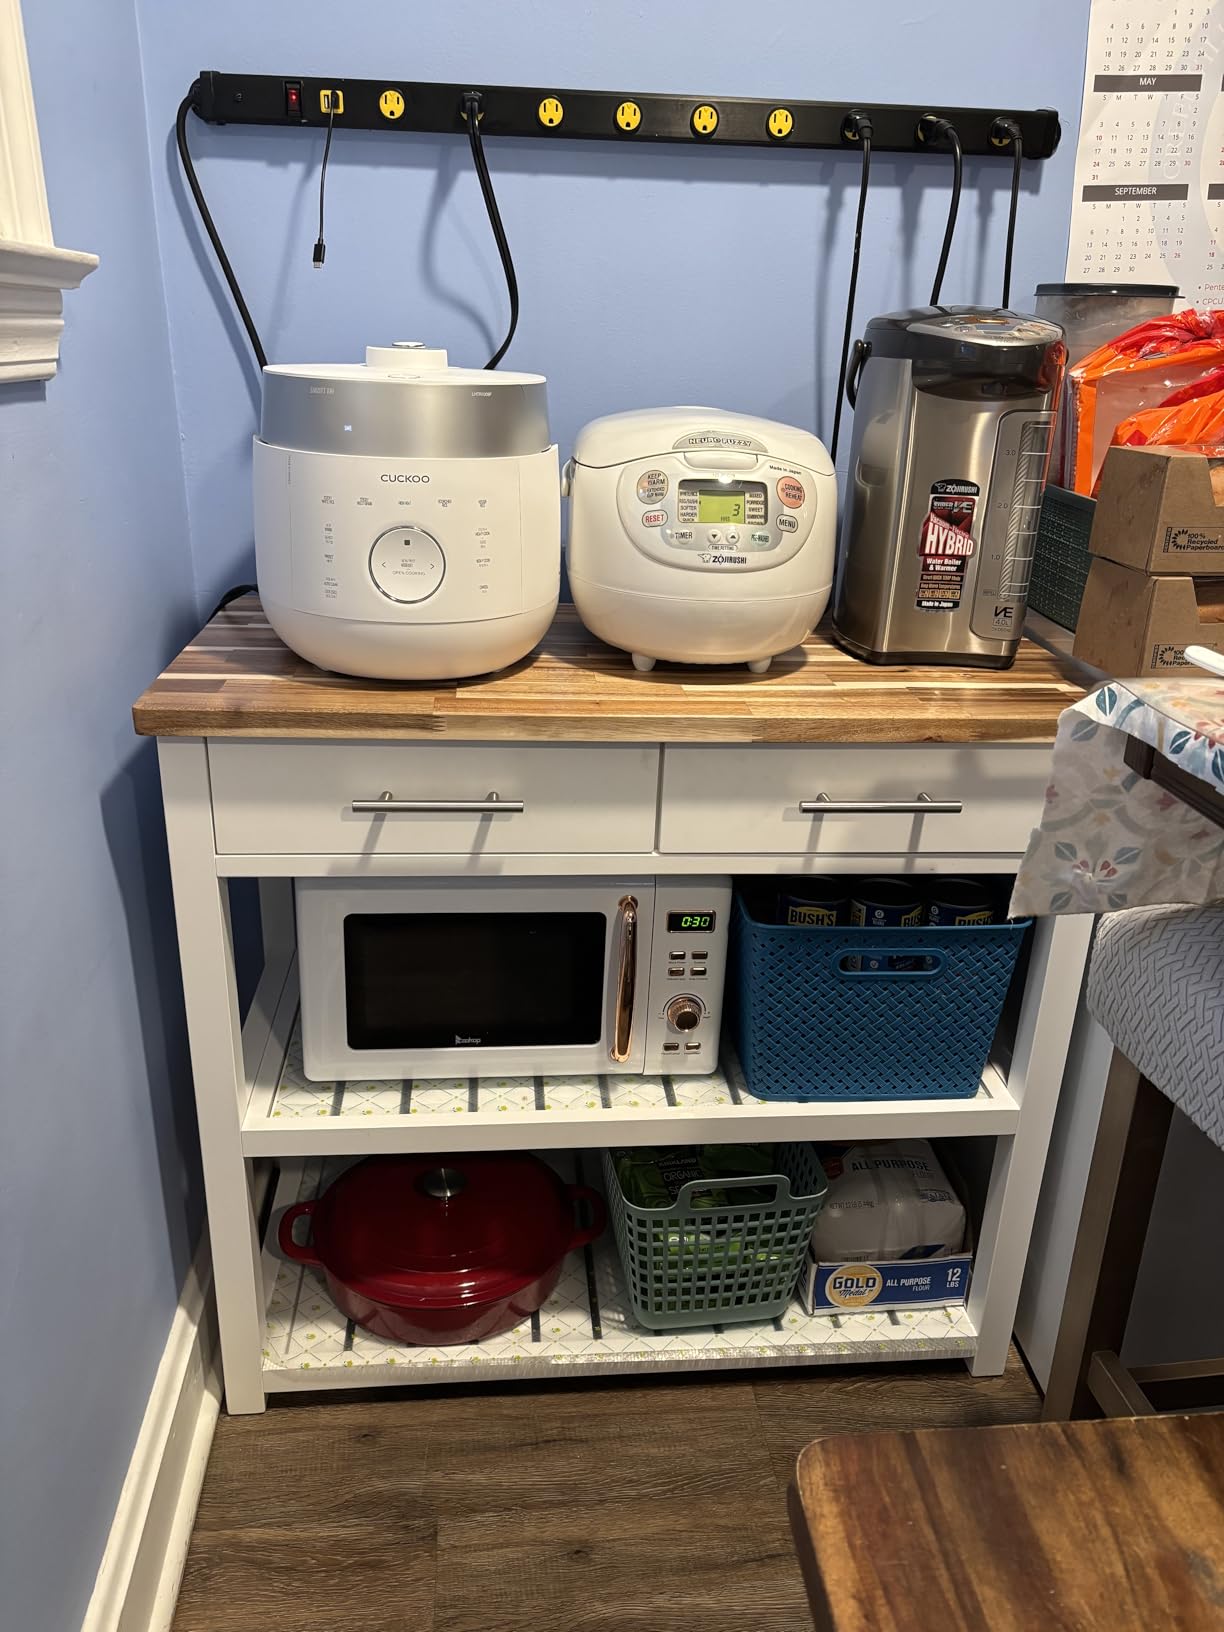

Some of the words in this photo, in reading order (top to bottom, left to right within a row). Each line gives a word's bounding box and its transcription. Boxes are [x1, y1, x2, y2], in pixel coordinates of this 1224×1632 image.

[1140, 77, 1156, 86] MAY
[1114, 187, 1157, 196] SEPTEMBER
[380, 474, 430, 483] CUCKOO
[732, 504, 740, 516] 3
[645, 514, 664, 523] RESET
[779, 519, 795, 528] MENU
[925, 522, 974, 555] HYBRID
[712, 555, 746, 565] ZOJIRUSHI
[994, 606, 1014, 618] VE
[682, 916, 710, 927] 0:30
[790, 909, 834, 926] BUSH'S
[852, 1160, 872, 1171] ALL
[875, 1159, 929, 1171] PURPOSE
[947, 1268, 961, 1281] 12
[832, 1276, 877, 1290] GOLD
[900, 1276, 932, 1286] PURPOSE
[839, 1288, 866, 1298] Medal
